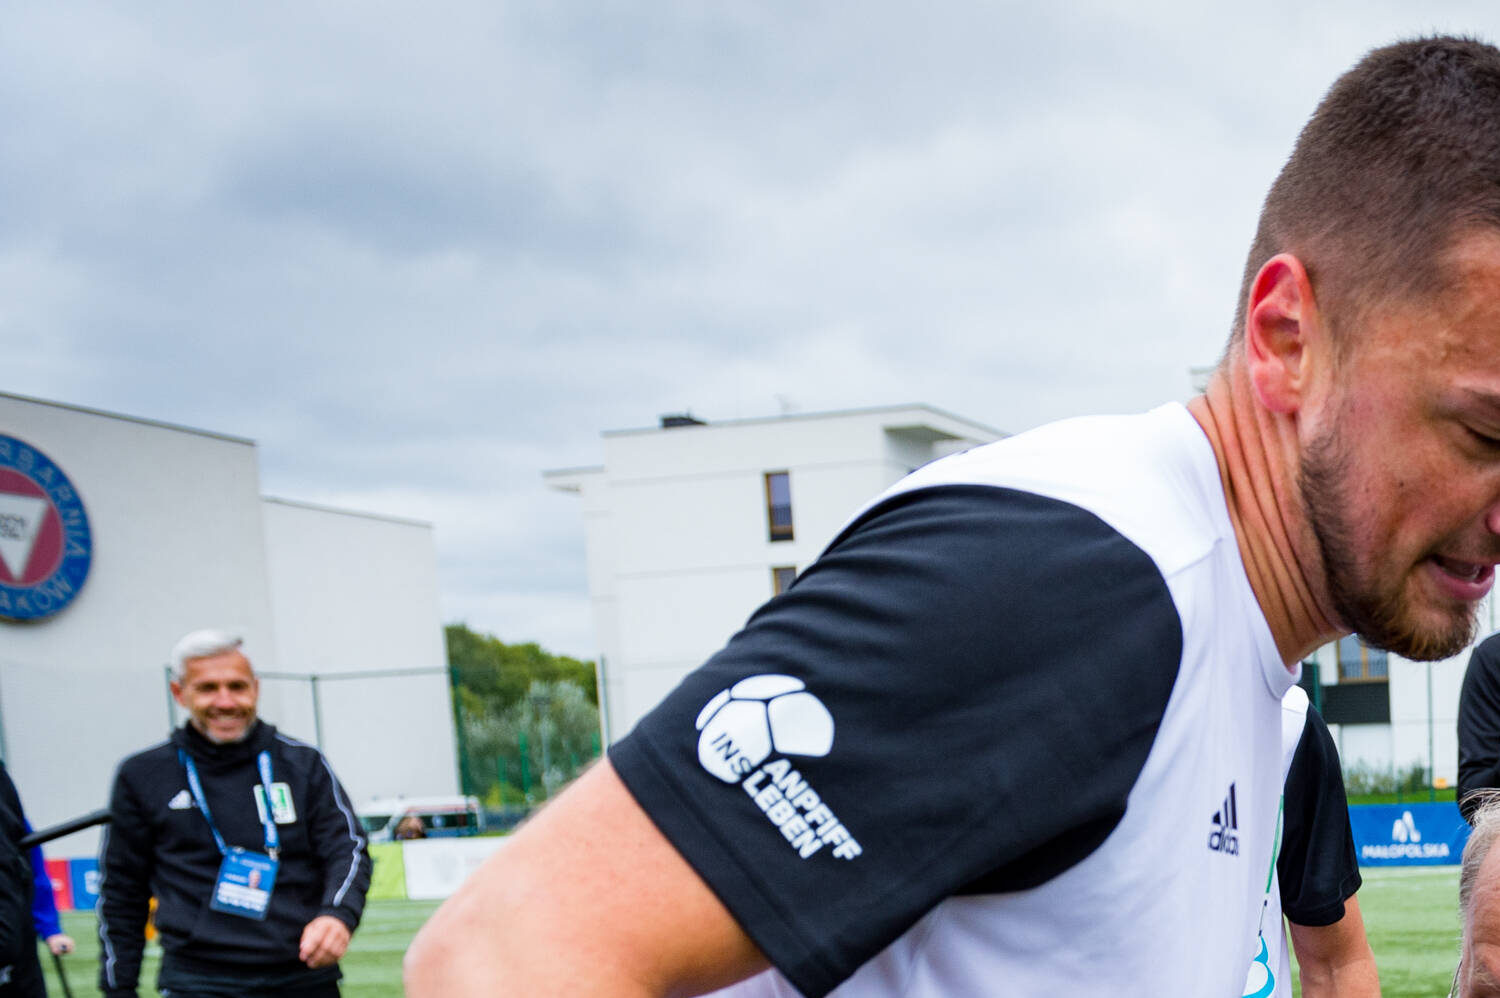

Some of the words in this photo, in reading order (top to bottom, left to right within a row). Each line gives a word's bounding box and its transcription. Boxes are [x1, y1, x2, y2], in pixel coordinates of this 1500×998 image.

[710, 732, 753, 775] INS
[741, 769, 823, 859] LEBEN
[762, 758, 863, 860] ANPFIFF
